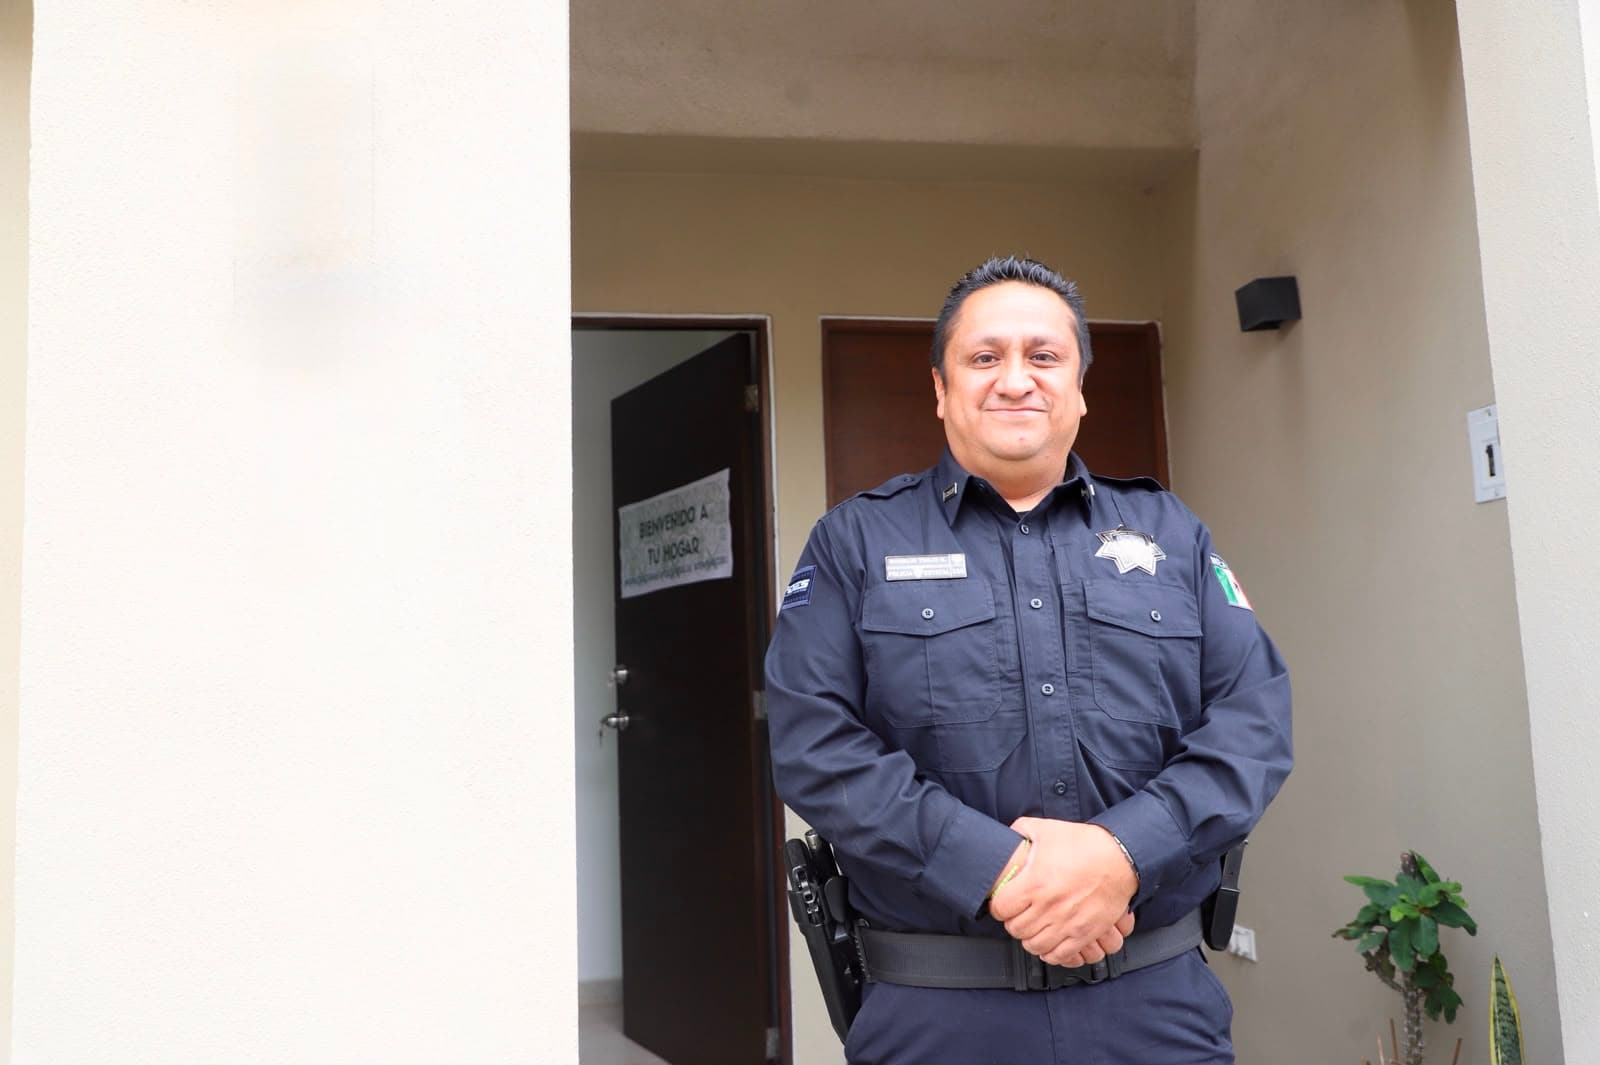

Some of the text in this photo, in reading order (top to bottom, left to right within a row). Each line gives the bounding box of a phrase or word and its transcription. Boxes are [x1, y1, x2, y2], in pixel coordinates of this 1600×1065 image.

[639, 504, 709, 538] BIENVENIDO A
[648, 537, 699, 565] TU HOGAR
